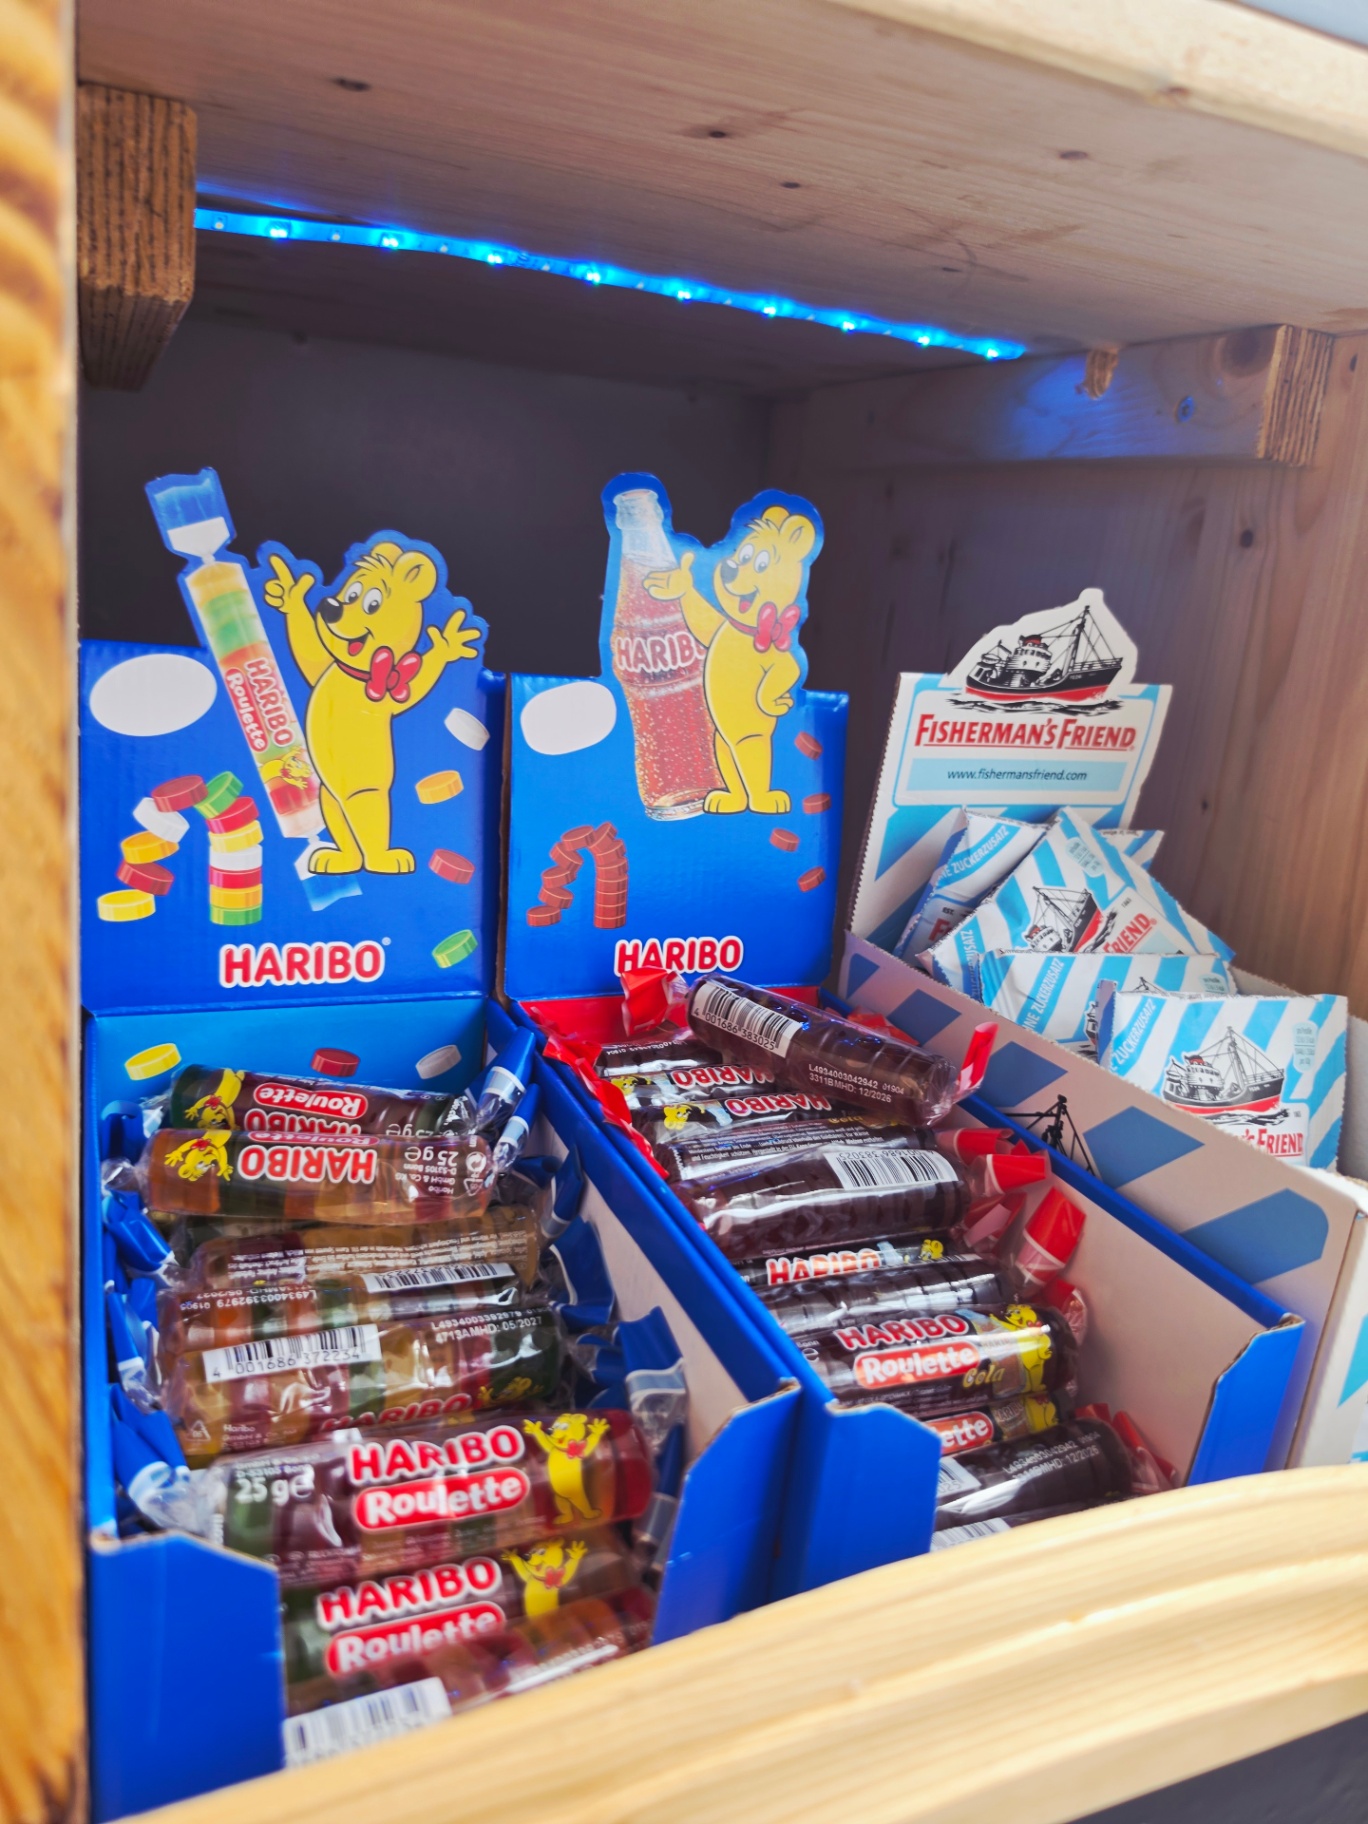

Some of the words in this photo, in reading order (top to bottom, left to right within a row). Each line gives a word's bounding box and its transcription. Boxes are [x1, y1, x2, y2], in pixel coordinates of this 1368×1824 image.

[615, 631, 706, 673] HARIB
[226, 672, 266, 750] Roulette
[244, 657, 294, 747] HARIBO
[1057, 718, 1136, 750] FRIEND
[947, 768, 1088, 781] www.fishermansfriend.com
[951, 825, 1009, 874] ZUCKERZUSATZ
[219, 941, 386, 988] HARIBO
[614, 935, 744, 977] HARIBO
[260, 1087, 361, 1117] Roulette
[237, 1145, 378, 1184] HARIBO
[833, 1314, 969, 1350] HARIBO
[862, 1347, 976, 1385] Roulette
[962, 1365, 1006, 1388] Cola
[349, 1425, 525, 1486] HARIBO
[234, 1476, 268, 1503] 25
[365, 1475, 523, 1526] Roulette
[317, 1556, 501, 1631] HARIBO
[336, 1611, 498, 1672] Roulette
